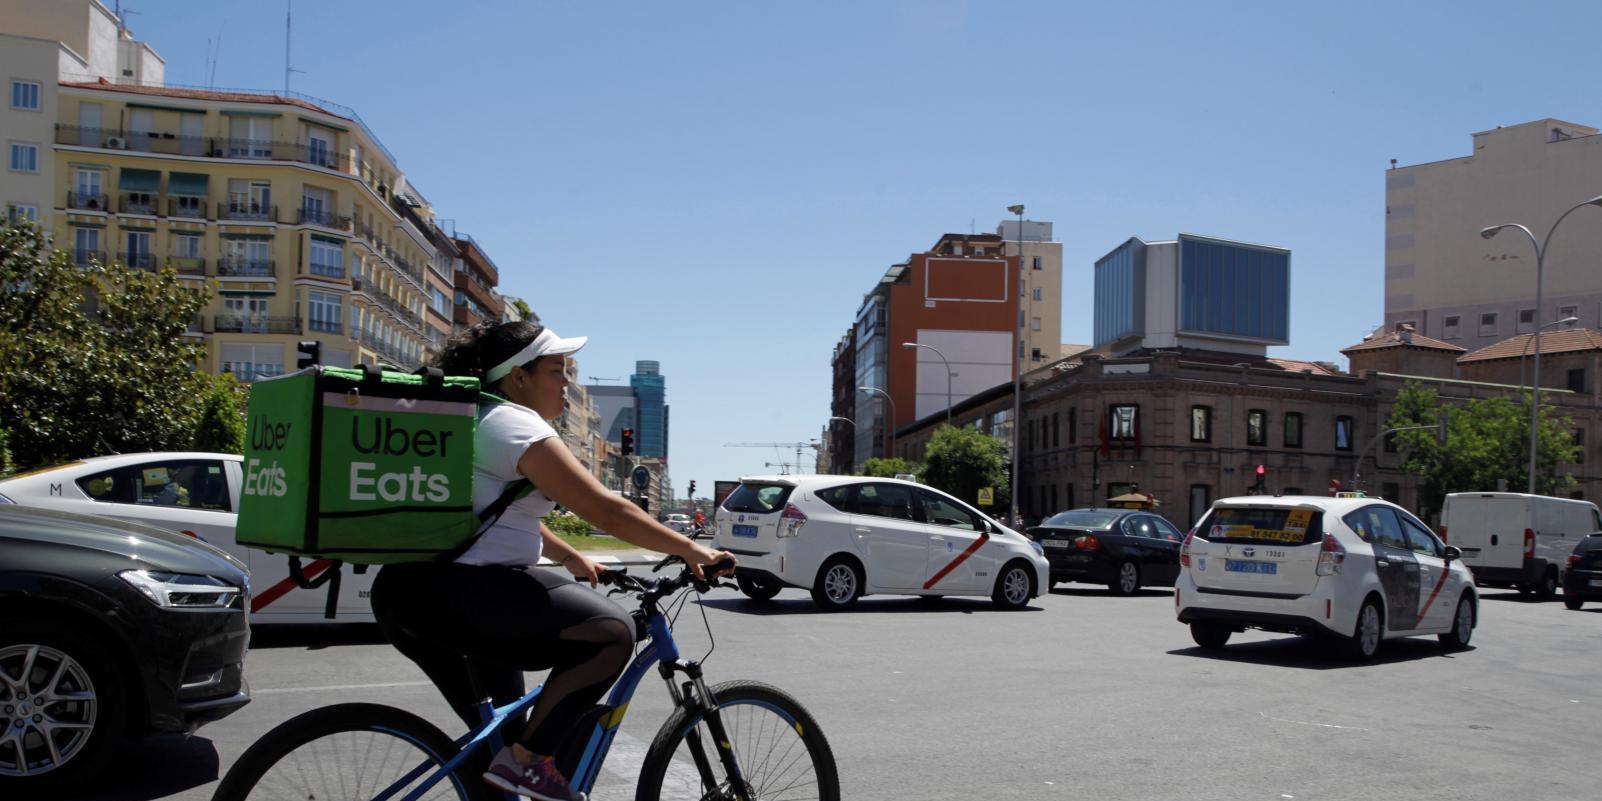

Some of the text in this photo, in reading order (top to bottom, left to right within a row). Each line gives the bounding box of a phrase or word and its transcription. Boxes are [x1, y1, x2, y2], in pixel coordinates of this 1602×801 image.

[252, 415, 293, 451] Uber
[352, 416, 453, 457] Uber
[50, 483, 62, 496] M
[244, 459, 288, 497] Eats
[349, 462, 450, 503] Eats
[1224, 545, 1233, 557] X
